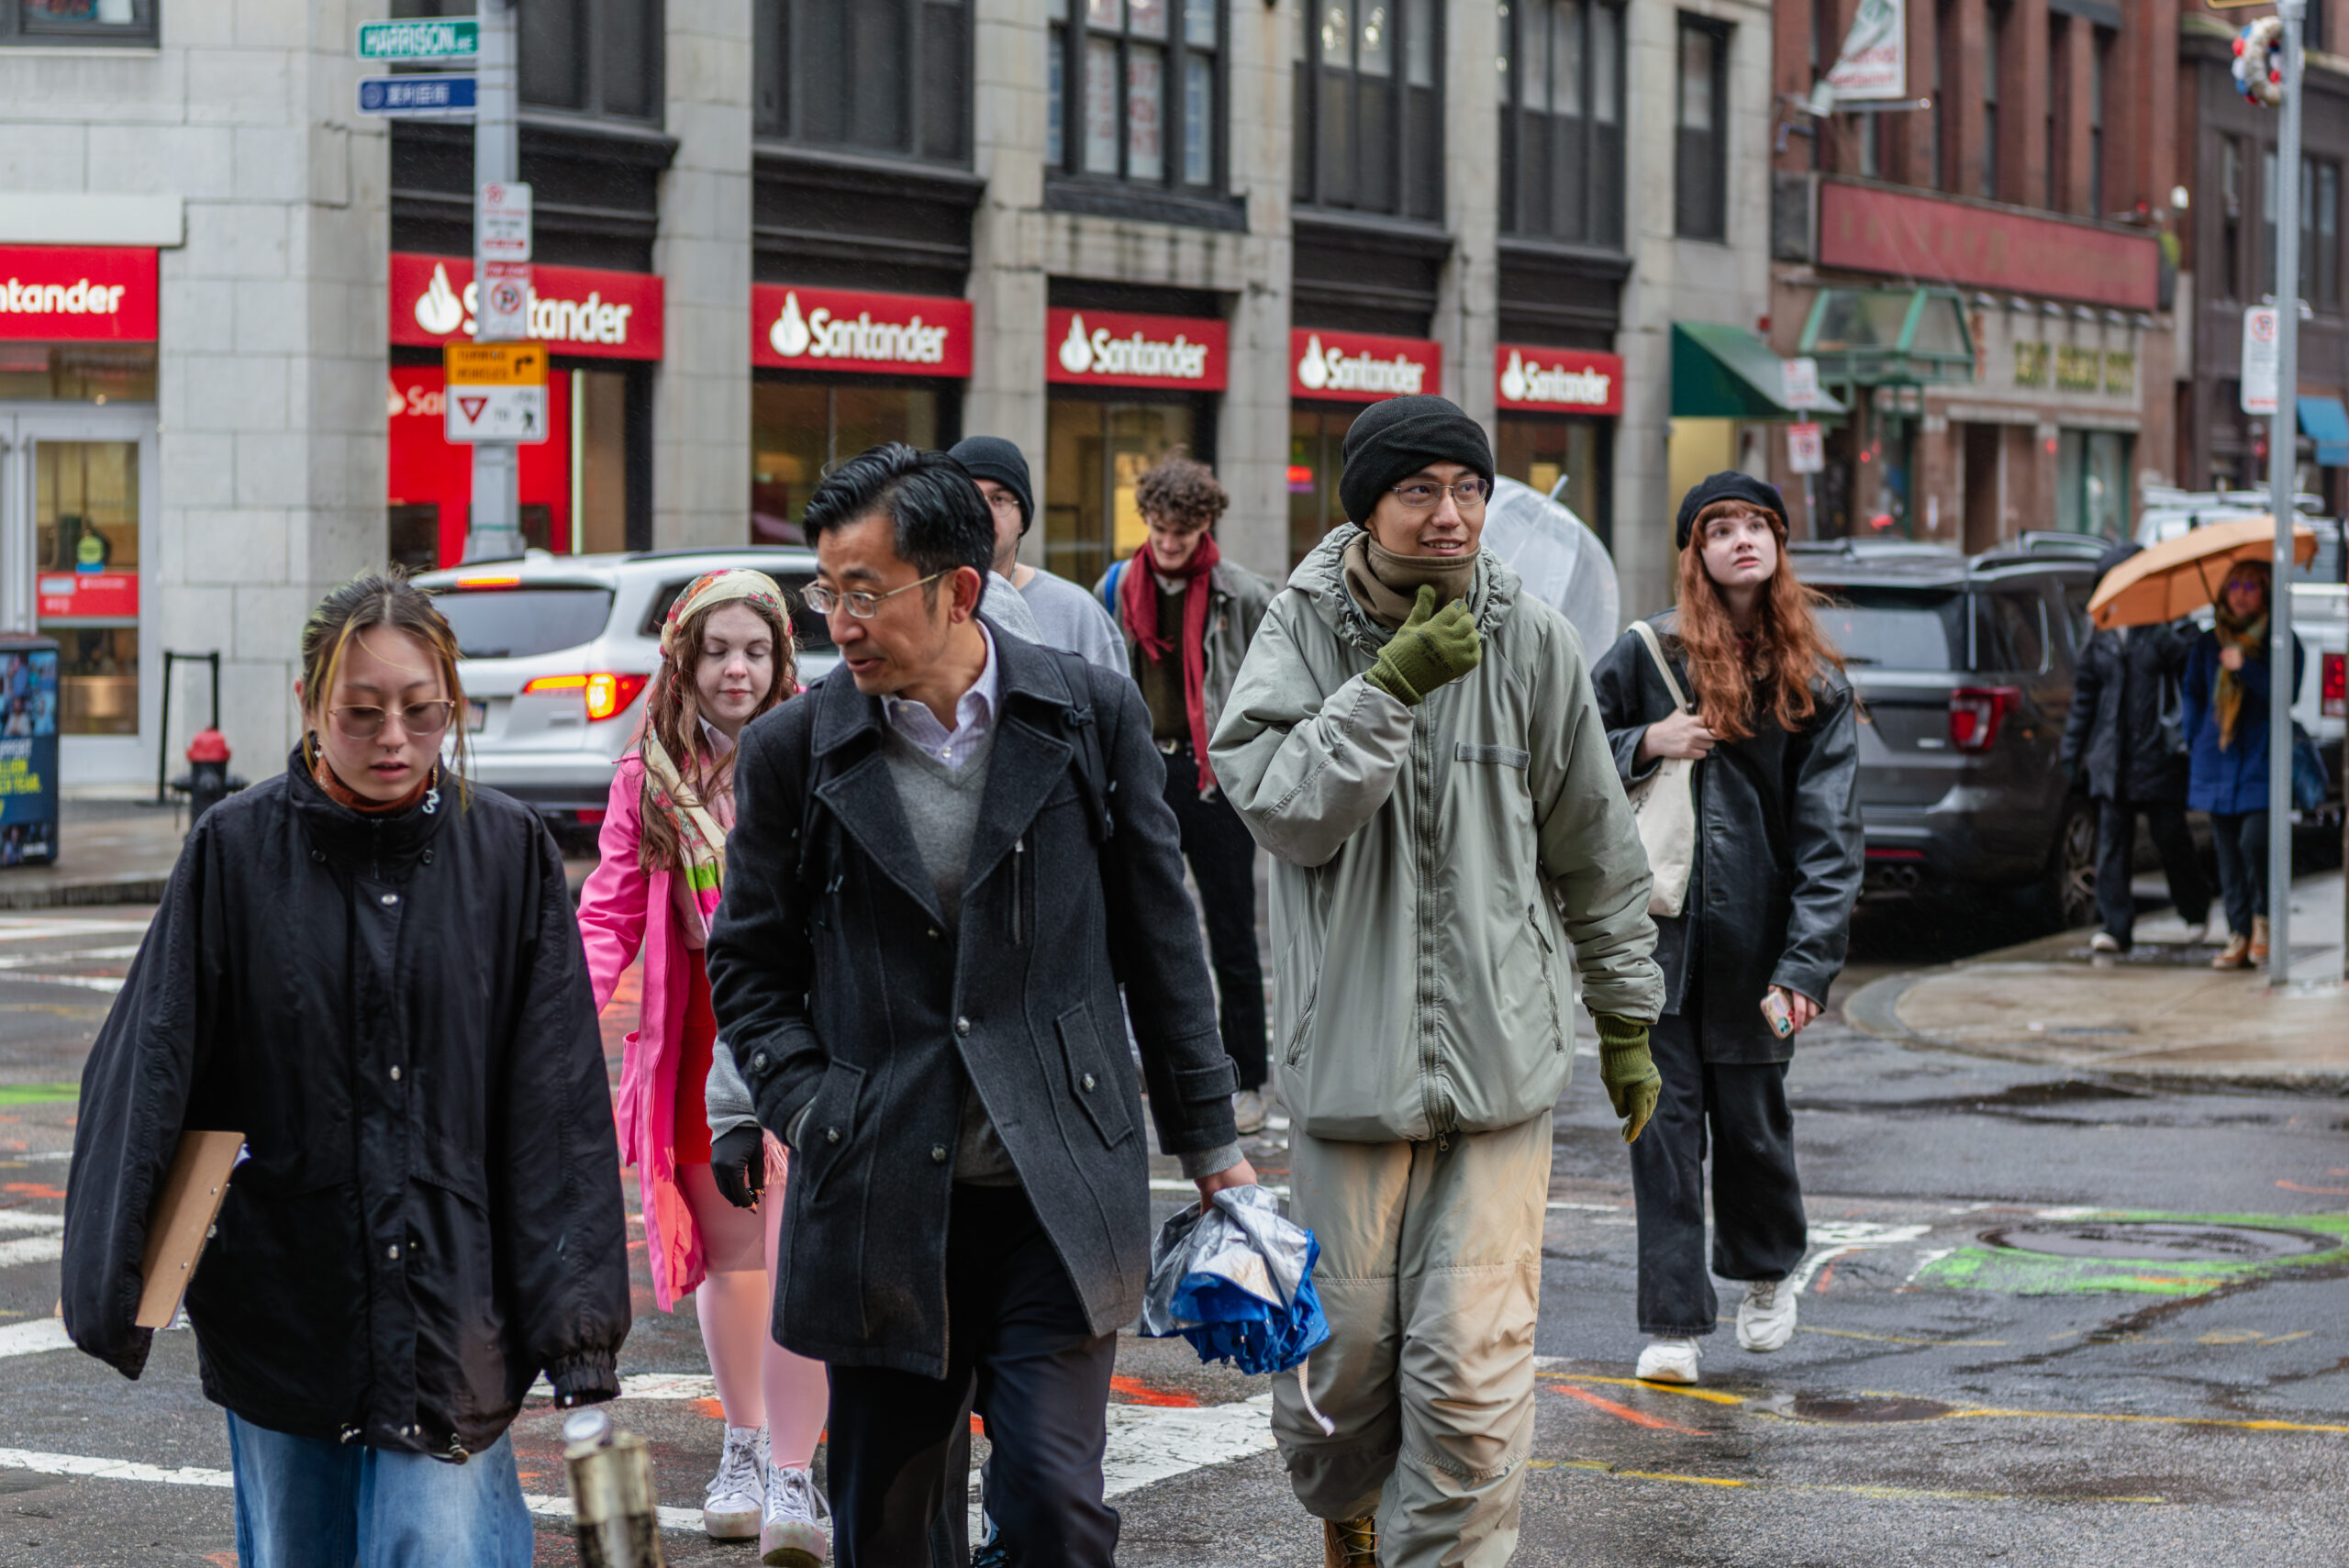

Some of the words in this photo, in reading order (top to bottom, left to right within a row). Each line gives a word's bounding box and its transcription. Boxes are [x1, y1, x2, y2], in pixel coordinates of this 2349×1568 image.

[364, 26, 455, 55] HARRISON
[462, 281, 632, 344] Stander
[808, 307, 949, 363] Santander
[457, 368, 508, 380] VEHICLES
[458, 350, 507, 361] TURNING
[1092, 328, 1208, 380] Santander
[1326, 347, 1426, 395] Santander
[1524, 361, 1611, 406] Santander
